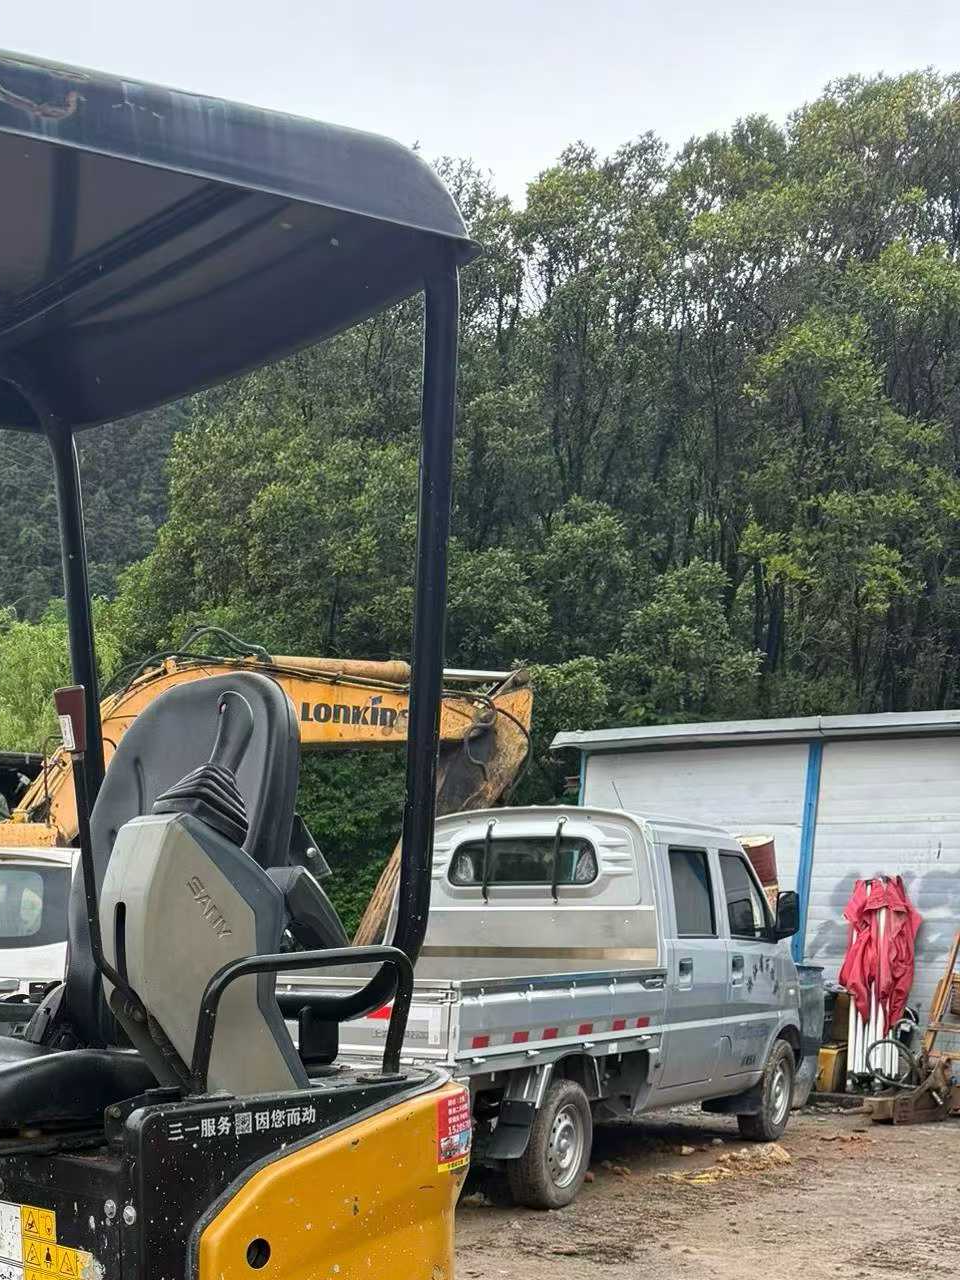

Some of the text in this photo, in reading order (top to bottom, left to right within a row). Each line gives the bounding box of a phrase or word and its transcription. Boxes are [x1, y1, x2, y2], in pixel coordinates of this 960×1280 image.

[185, 876, 233, 939] SANY
[168, 1105, 316, 1141] 三一服务 因您而动
